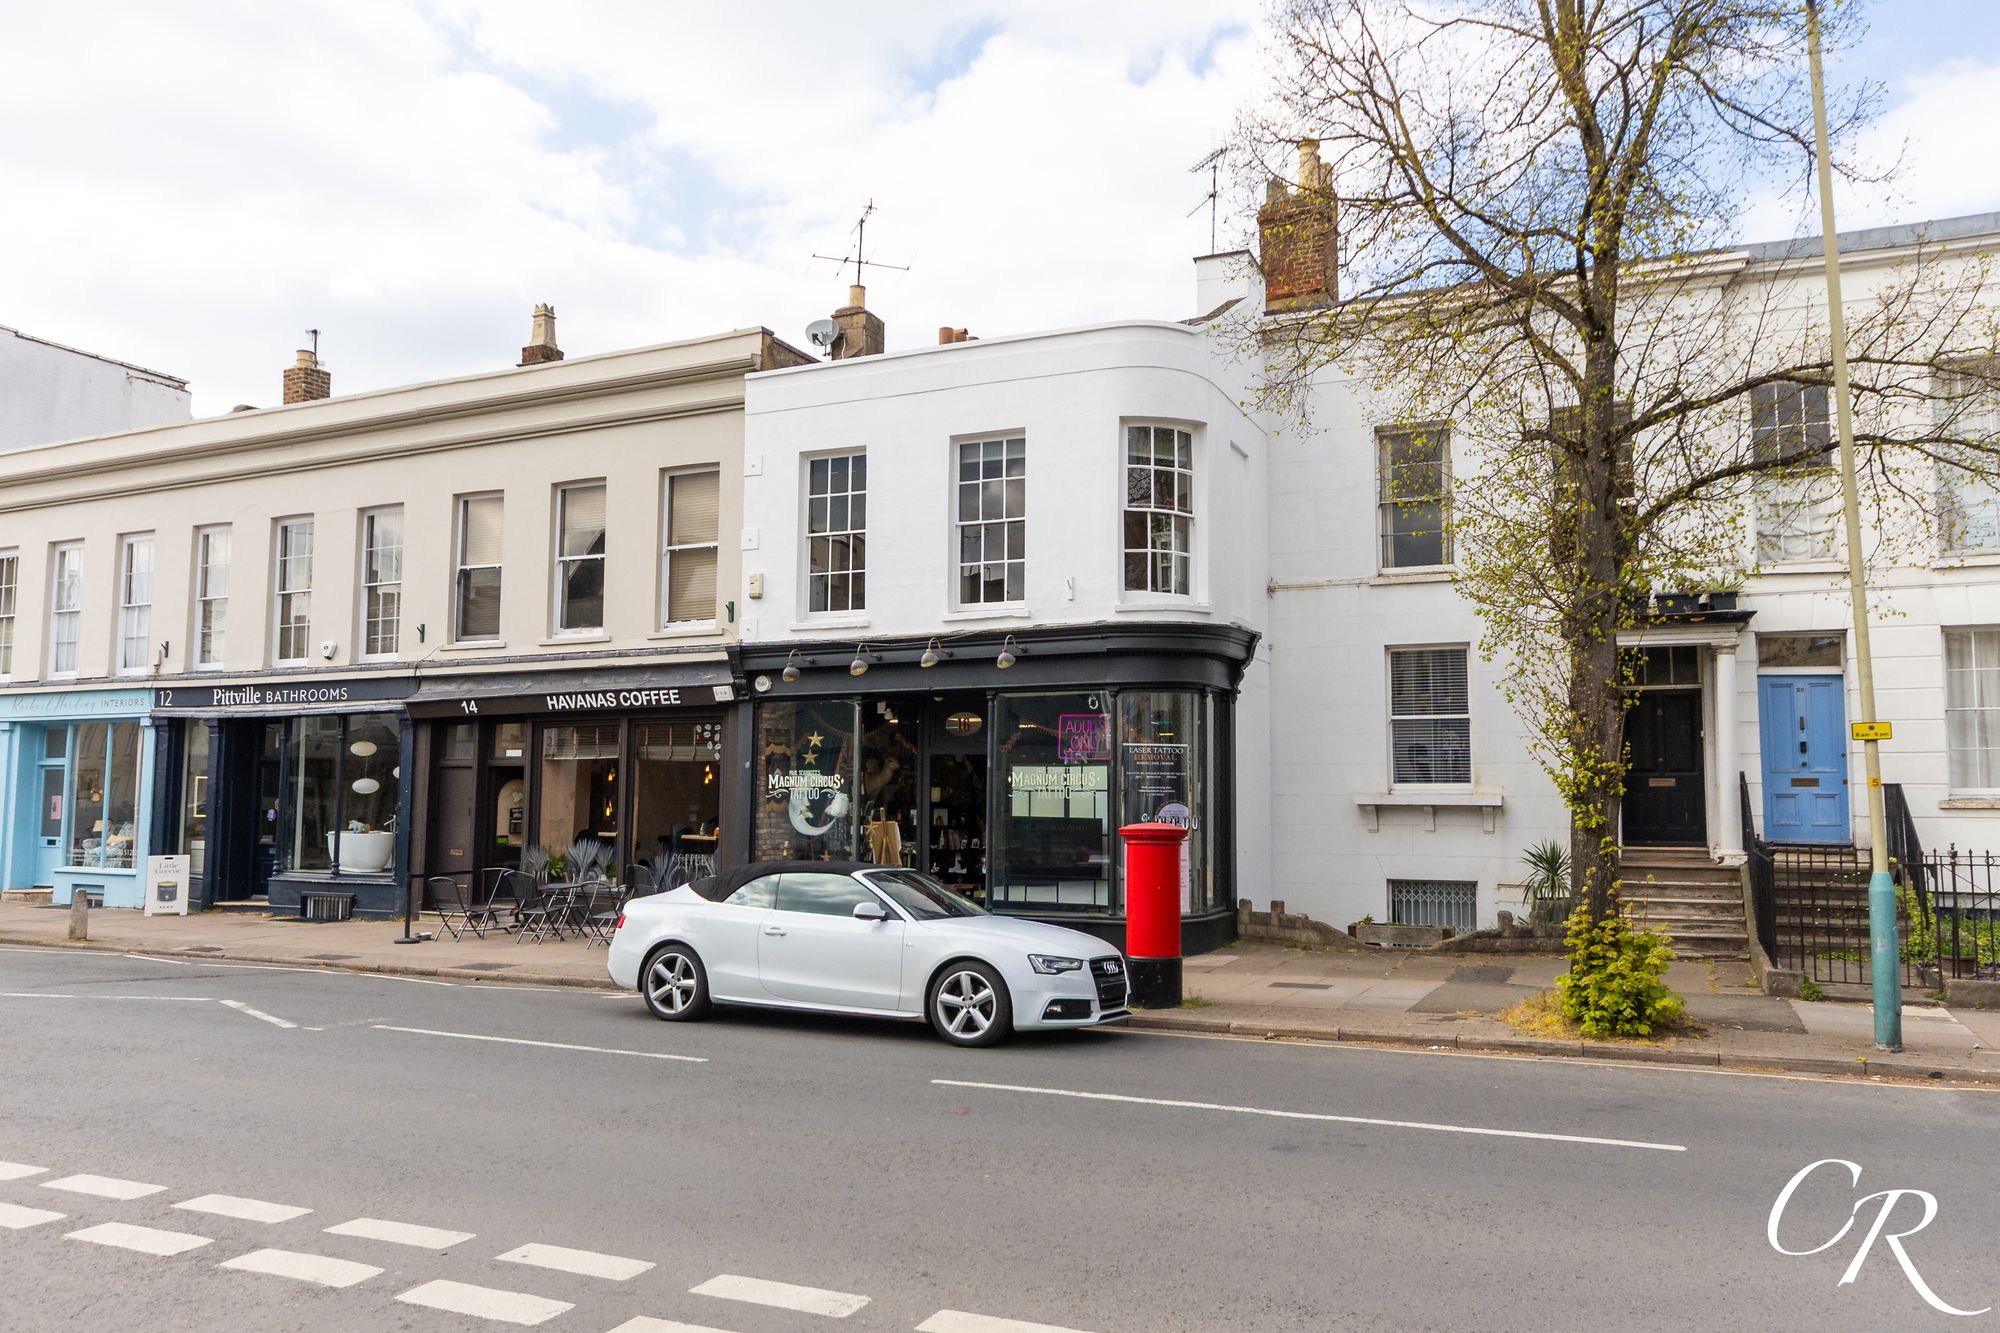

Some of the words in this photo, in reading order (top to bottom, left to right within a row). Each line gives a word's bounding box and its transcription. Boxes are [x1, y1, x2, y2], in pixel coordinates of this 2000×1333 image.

[101, 698, 145, 708] INTERIORS
[159, 690, 172, 706] 12
[212, 687, 261, 705] Pittville
[266, 687, 348, 703] BATHROOMS
[546, 692, 617, 710] HAVANAS
[619, 689, 681, 708] COFFEE
[461, 699, 478, 714] 14
[957, 717, 970, 733] 16
[1070, 736, 1101, 749] ONLY
[768, 774, 808, 789] MAGNUM
[810, 773, 841, 789] CIRCUS
[1012, 771, 1058, 787] MAGNUM
[1060, 771, 1096, 787] CIRCUS
[1872, 779, 1879, 787] 5
[788, 787, 820, 800] TATTOO
[1038, 786, 1072, 799] TATTOO
